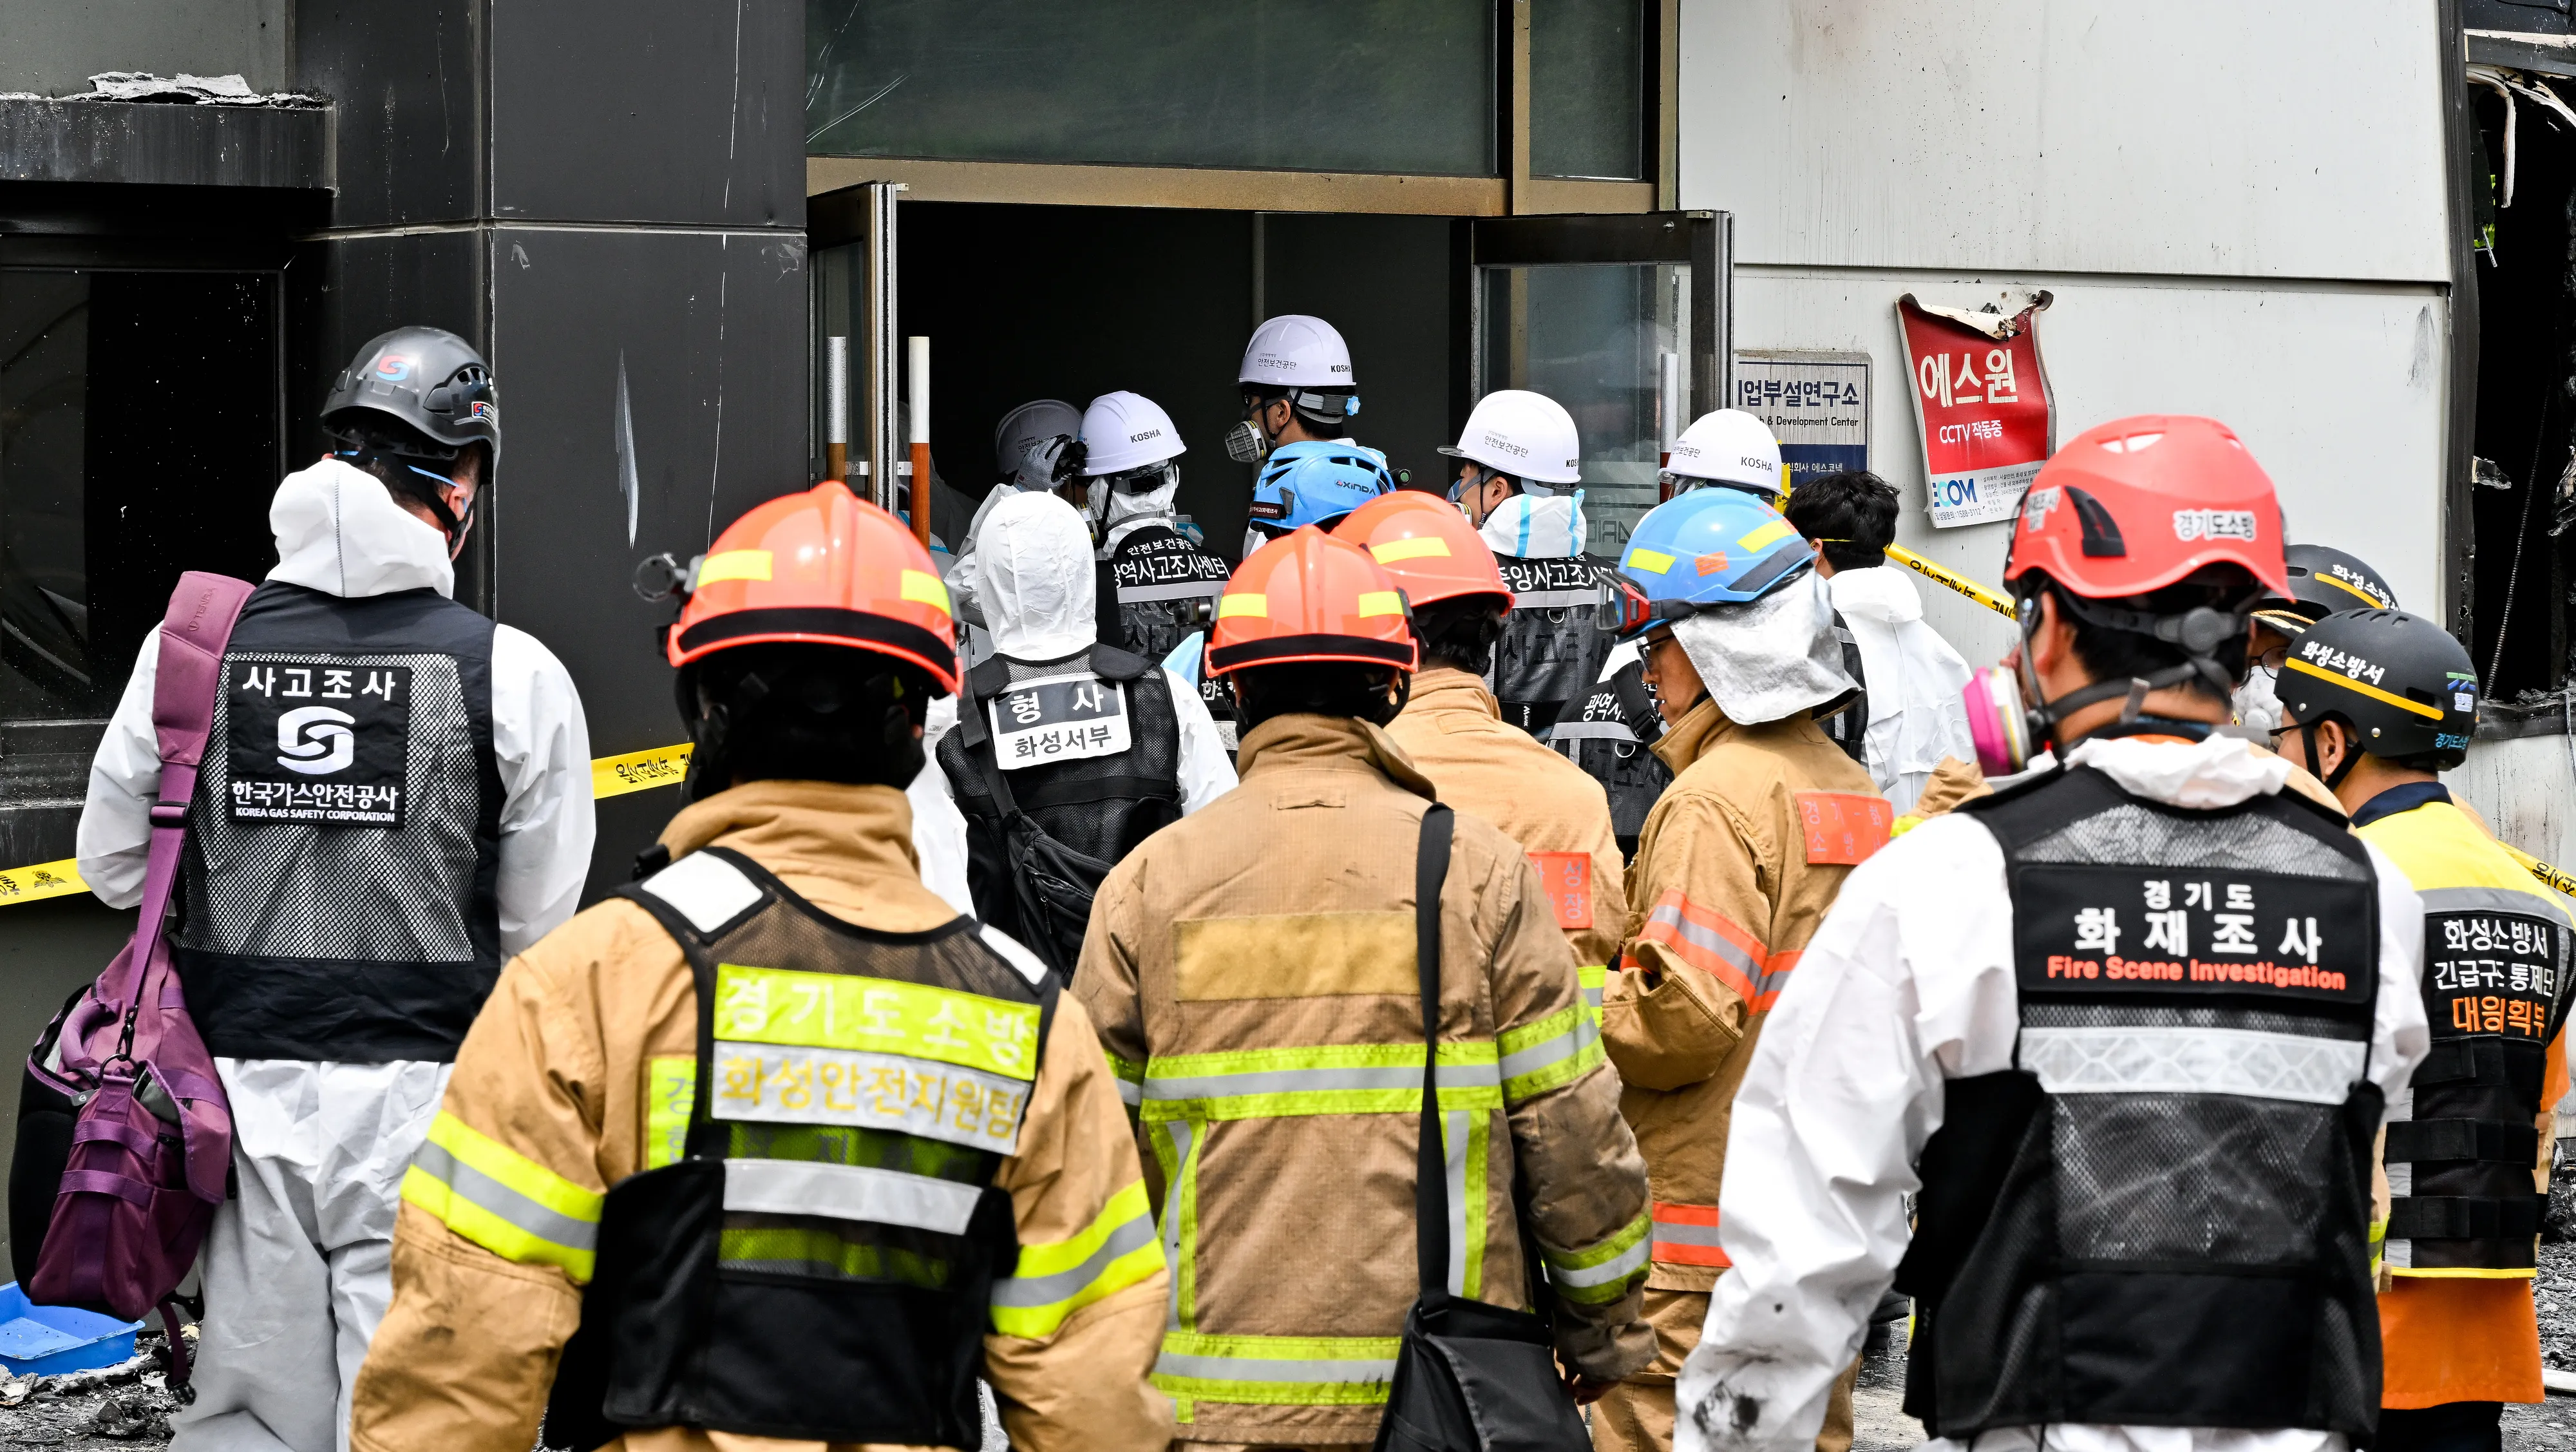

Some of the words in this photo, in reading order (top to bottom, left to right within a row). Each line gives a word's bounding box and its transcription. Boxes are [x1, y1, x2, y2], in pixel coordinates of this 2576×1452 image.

[1258, 358, 1297, 370] 안전보건공단
[1920, 349, 2018, 408] 에스원
[1130, 428, 1161, 443] KOSHA
[1767, 416, 1774, 425] &
[1776, 416, 1828, 428] Development
[1831, 417, 1859, 426] Center
[1939, 424, 1971, 444] CCTV
[1972, 419, 2002, 440] 작동중
[1484, 435, 1529, 458] 안전보건공단
[1741, 456, 1772, 472] KOSHA
[1812, 463, 1842, 473] 에스코넥
[2177, 512, 2253, 540] 경기도소방
[1127, 538, 1194, 556] 안전보건공단
[2301, 641, 2385, 686] 화성소방서
[242, 665, 396, 701] 사고조사
[1009, 684, 1104, 724] 형사
[1014, 725, 1112, 758] 화성서부
[231, 780, 399, 810] 한국가스안전공사
[236, 807, 268, 817] KOREA
[269, 808, 289, 818] GAS
[290, 809, 325, 819] SAFETY
[326, 810, 395, 822] CORPORATION
[2144, 880, 2255, 911] 경기도
[2074, 906, 2323, 964] 화재조사
[2443, 919, 2549, 959] 화성소방서
[2047, 955, 2099, 979] Fire
[2105, 956, 2184, 982] Scene
[2190, 959, 2346, 990] Investigation
[724, 977, 1039, 1067] 경기도소방
[719, 1055, 1022, 1140] 화성안전지원팀
